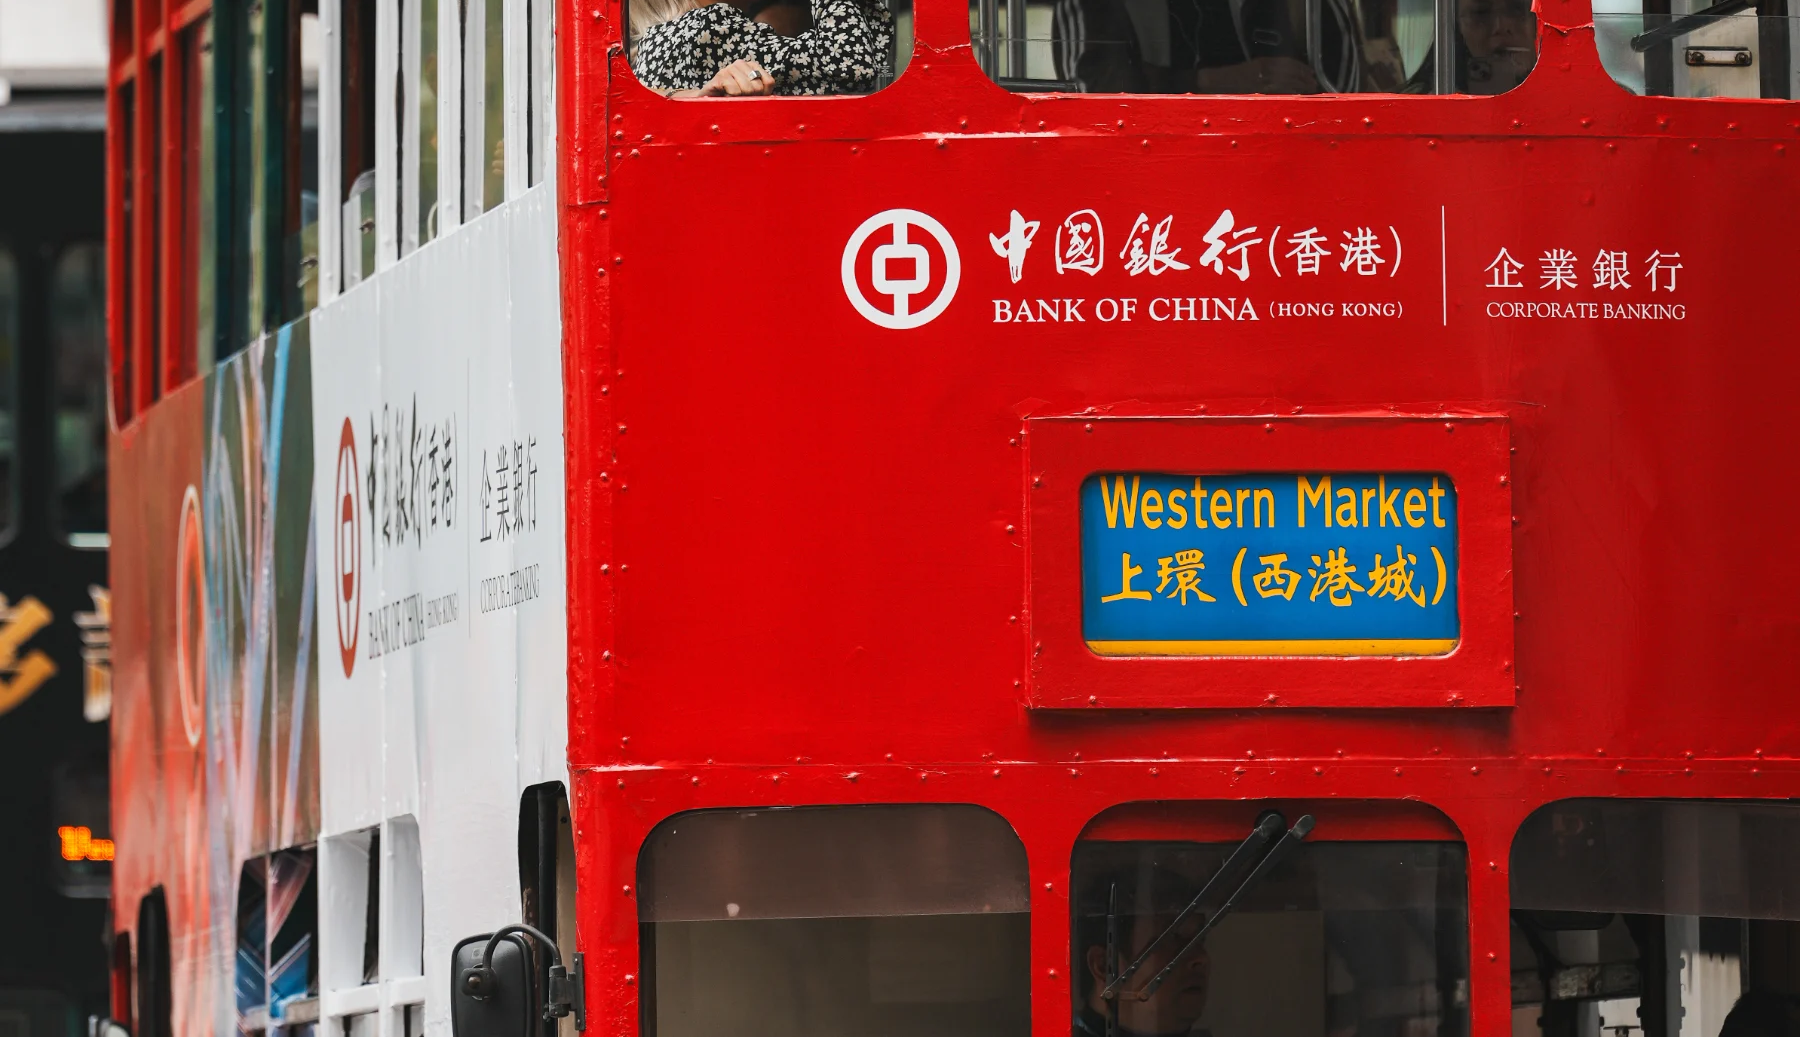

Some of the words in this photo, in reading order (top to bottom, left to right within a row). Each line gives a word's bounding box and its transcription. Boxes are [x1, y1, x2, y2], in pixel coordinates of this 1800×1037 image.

[1484, 246, 1684, 293] 企業銀行
[992, 298, 1085, 323] BANK
[1095, 298, 1138, 322] OF
[1148, 297, 1260, 321] CHINA
[1269, 302, 1335, 319] (HONG
[1341, 302, 1403, 319] KONG)
[1486, 301, 1599, 319] CORPORATE
[1603, 303, 1686, 320] BANKING
[480, 433, 538, 543] 企業銀行
[1100, 475, 1275, 529] Western
[1297, 475, 1446, 528] Market
[480, 570, 517, 614] CORPORATE
[516, 563, 540, 606] BANKING
